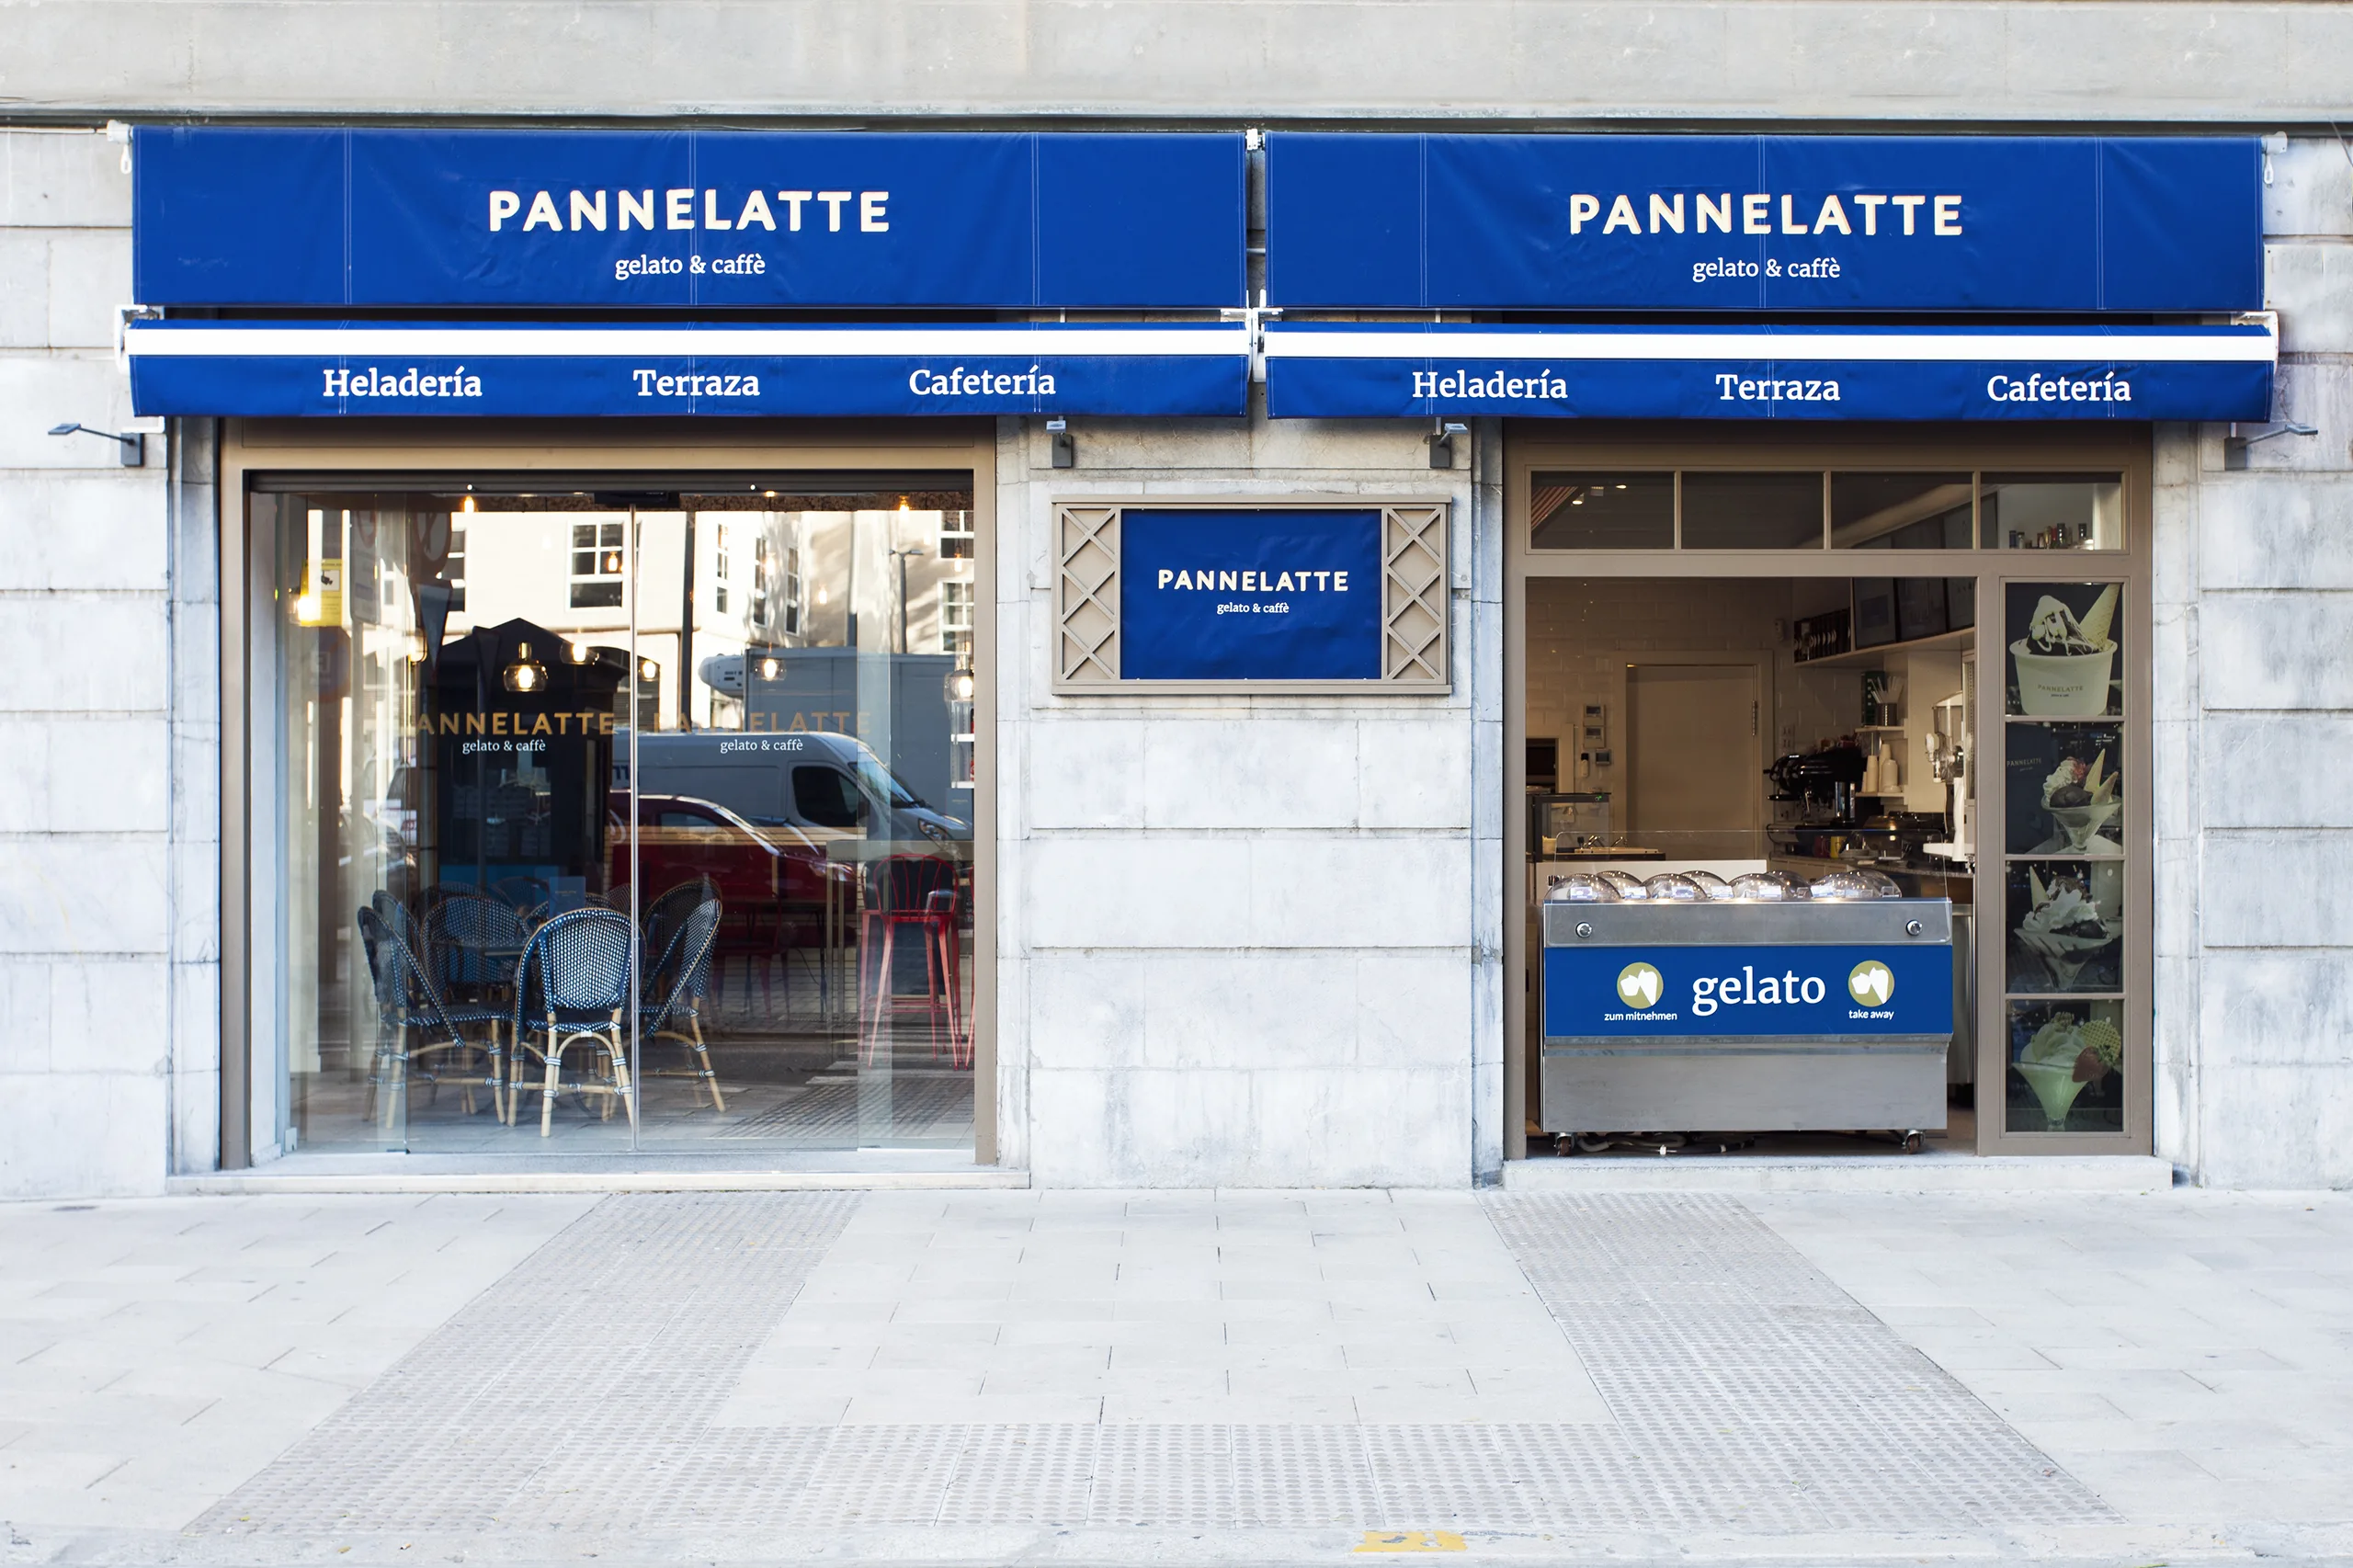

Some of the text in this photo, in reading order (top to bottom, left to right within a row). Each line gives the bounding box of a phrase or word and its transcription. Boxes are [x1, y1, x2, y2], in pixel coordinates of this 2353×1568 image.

[489, 187, 890, 233] PANNELATTE
[1570, 193, 1962, 237] PANNELATTE
[615, 253, 767, 280] gelato & caffè
[1692, 256, 1842, 283] gelato & caffè
[323, 364, 1056, 397] Heladería Terraza Cafetería
[1412, 368, 2132, 403] Heladería Terraza Cafetería
[1158, 569, 1348, 592] PANNELATTE
[1216, 601, 1290, 615] gelato & caffè
[403, 712, 615, 735] ANNELATTE
[462, 739, 546, 755] gelato & caffè
[720, 738, 803, 754] gelato & caffè
[1691, 965, 1826, 1017] gelato
[1604, 1010, 1677, 1021] zum mitnehmen
[1848, 1009, 1895, 1021] take away
